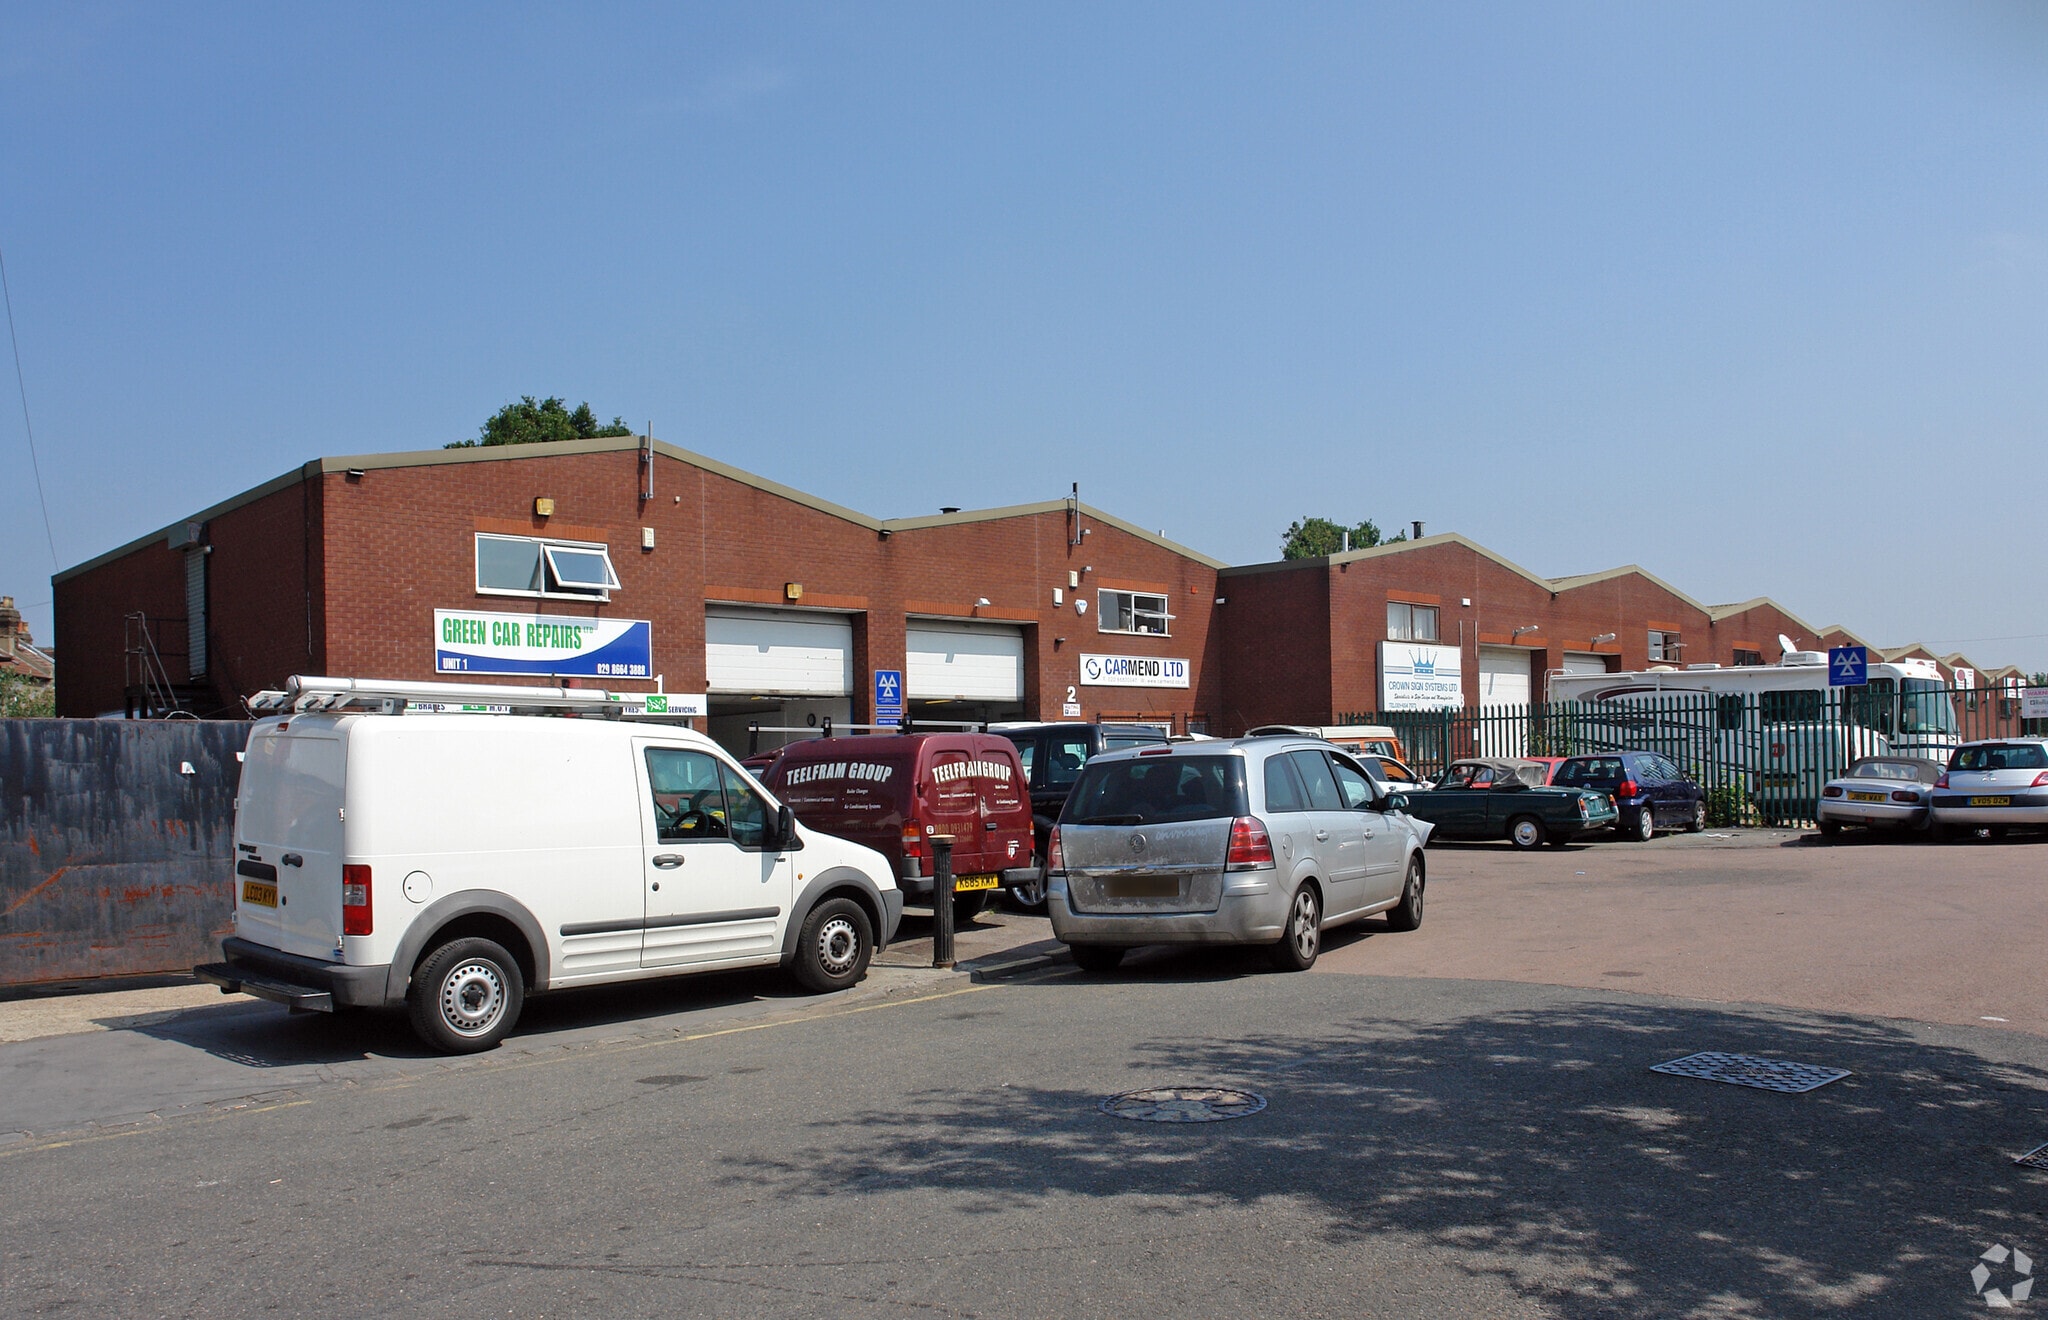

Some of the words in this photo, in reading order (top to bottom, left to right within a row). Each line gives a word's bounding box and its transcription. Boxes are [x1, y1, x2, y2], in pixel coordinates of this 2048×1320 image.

[442, 617, 487, 645] GREEN
[492, 621, 521, 647] CAR
[526, 623, 582, 650] REPAIRS
[583, 626, 594, 634] LTD
[442, 657, 461, 670] UNIT
[462, 658, 468, 670] 1
[1105, 659, 1159, 676] CARMEND
[1164, 662, 1183, 677] LTD
[653, 674, 664, 694] 1
[1388, 681, 1410, 690] CROWN
[1411, 682, 1423, 690] SIGN
[1425, 683, 1448, 691] SYSTEMS
[1067, 686, 1077, 702] 2
[786, 762, 847, 786] TEELFRAM
[848, 762, 893, 783] GROUP
[983, 762, 1011, 782] GROUP
